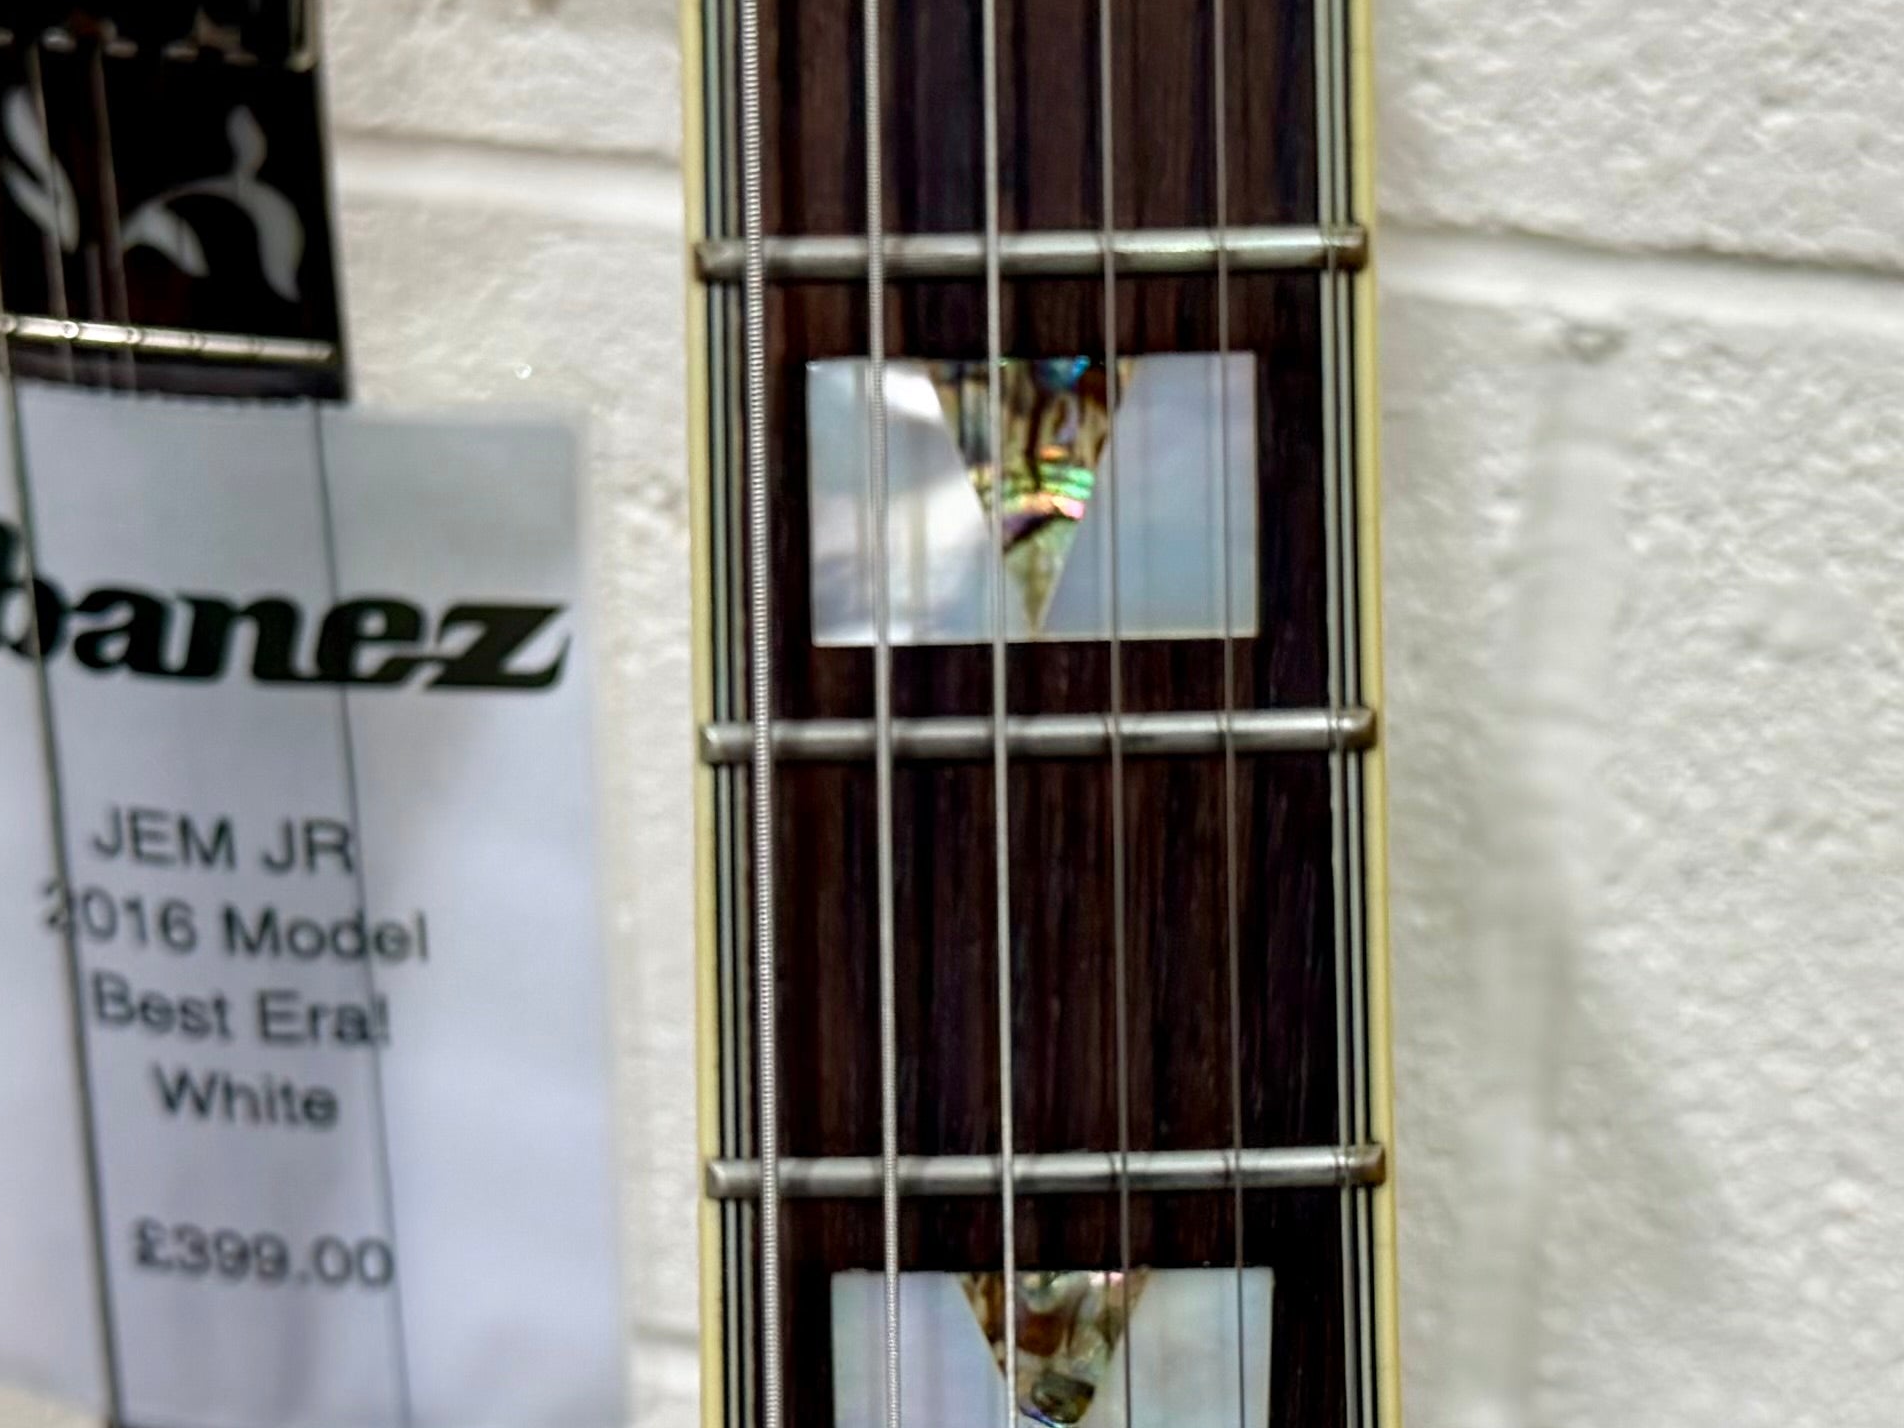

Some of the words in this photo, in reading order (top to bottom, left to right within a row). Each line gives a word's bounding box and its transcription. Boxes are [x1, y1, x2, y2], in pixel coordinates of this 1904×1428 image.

[92, 804, 236, 871] JEM
[260, 816, 354, 874] JR
[42, 876, 197, 955] 2016
[222, 902, 428, 963] Model
[91, 970, 230, 1042] Best
[152, 1064, 340, 1129] White
[132, 1217, 394, 1289] £399.00
